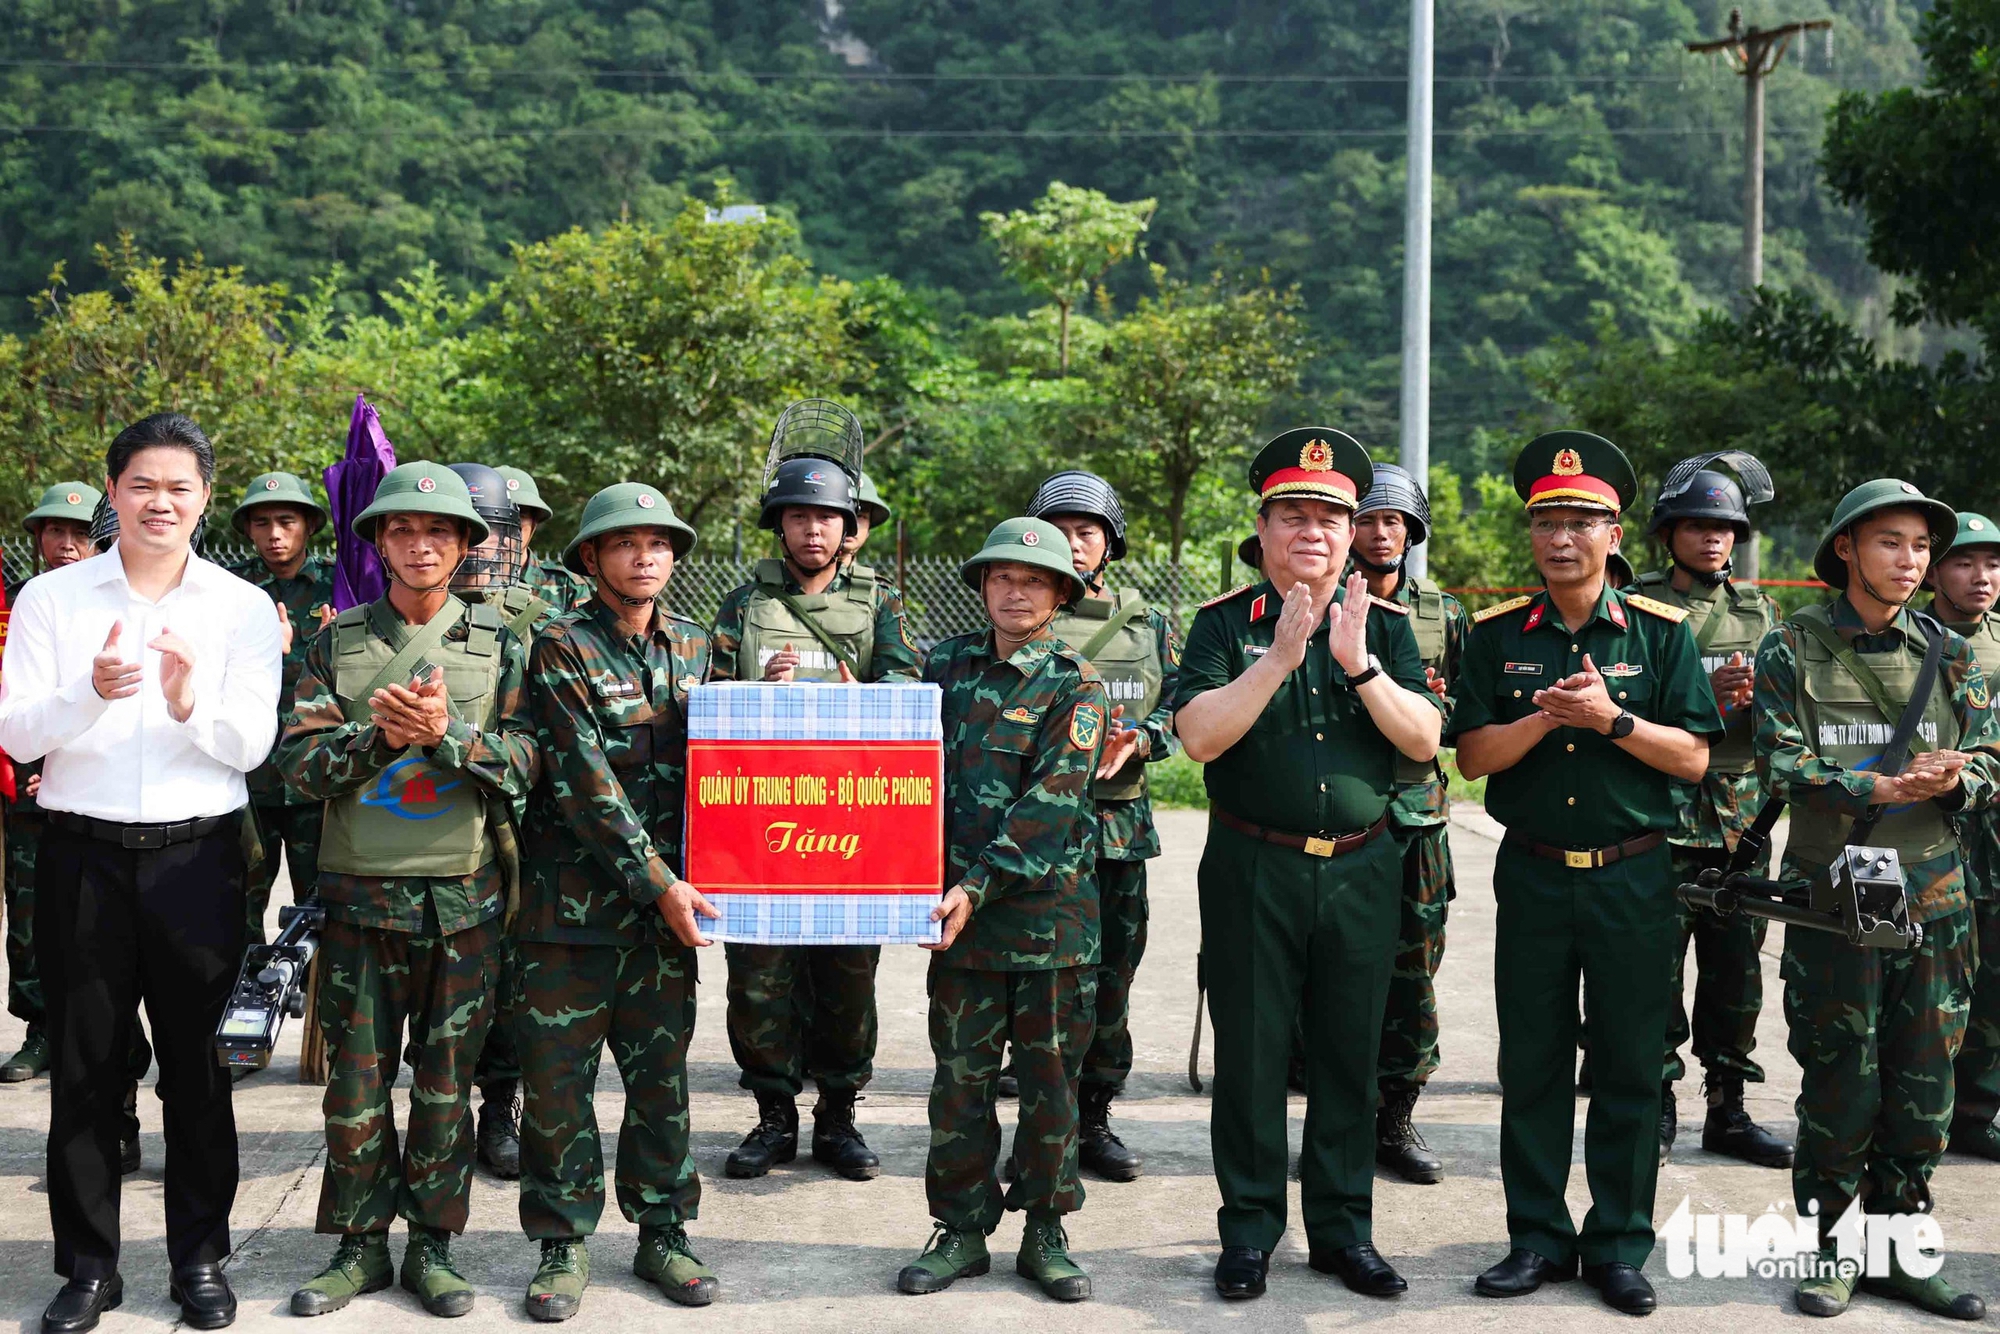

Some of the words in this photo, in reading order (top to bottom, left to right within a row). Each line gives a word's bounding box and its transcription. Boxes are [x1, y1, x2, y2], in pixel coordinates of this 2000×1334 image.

[1111, 678, 1123, 702] VẬT
[1132, 681, 1144, 700] 319
[1819, 721, 1838, 746] CÔNG
[1838, 725, 1847, 745] TY
[1848, 718, 1858, 744] XỬ
[1858, 720, 1867, 744] LÝ
[1868, 724, 1884, 744] BOM
[1924, 722, 1938, 743] 319
[699, 770, 732, 808] QUÂN
[734, 767, 750, 806] ỦY
[752, 776, 791, 806] TRUNG
[794, 773, 827, 806] ƯƠNG
[838, 771, 854, 812] BỘ
[857, 766, 888, 808] QUỐC
[891, 769, 932, 806] PHÒNG
[765, 821, 862, 859] Tặng
